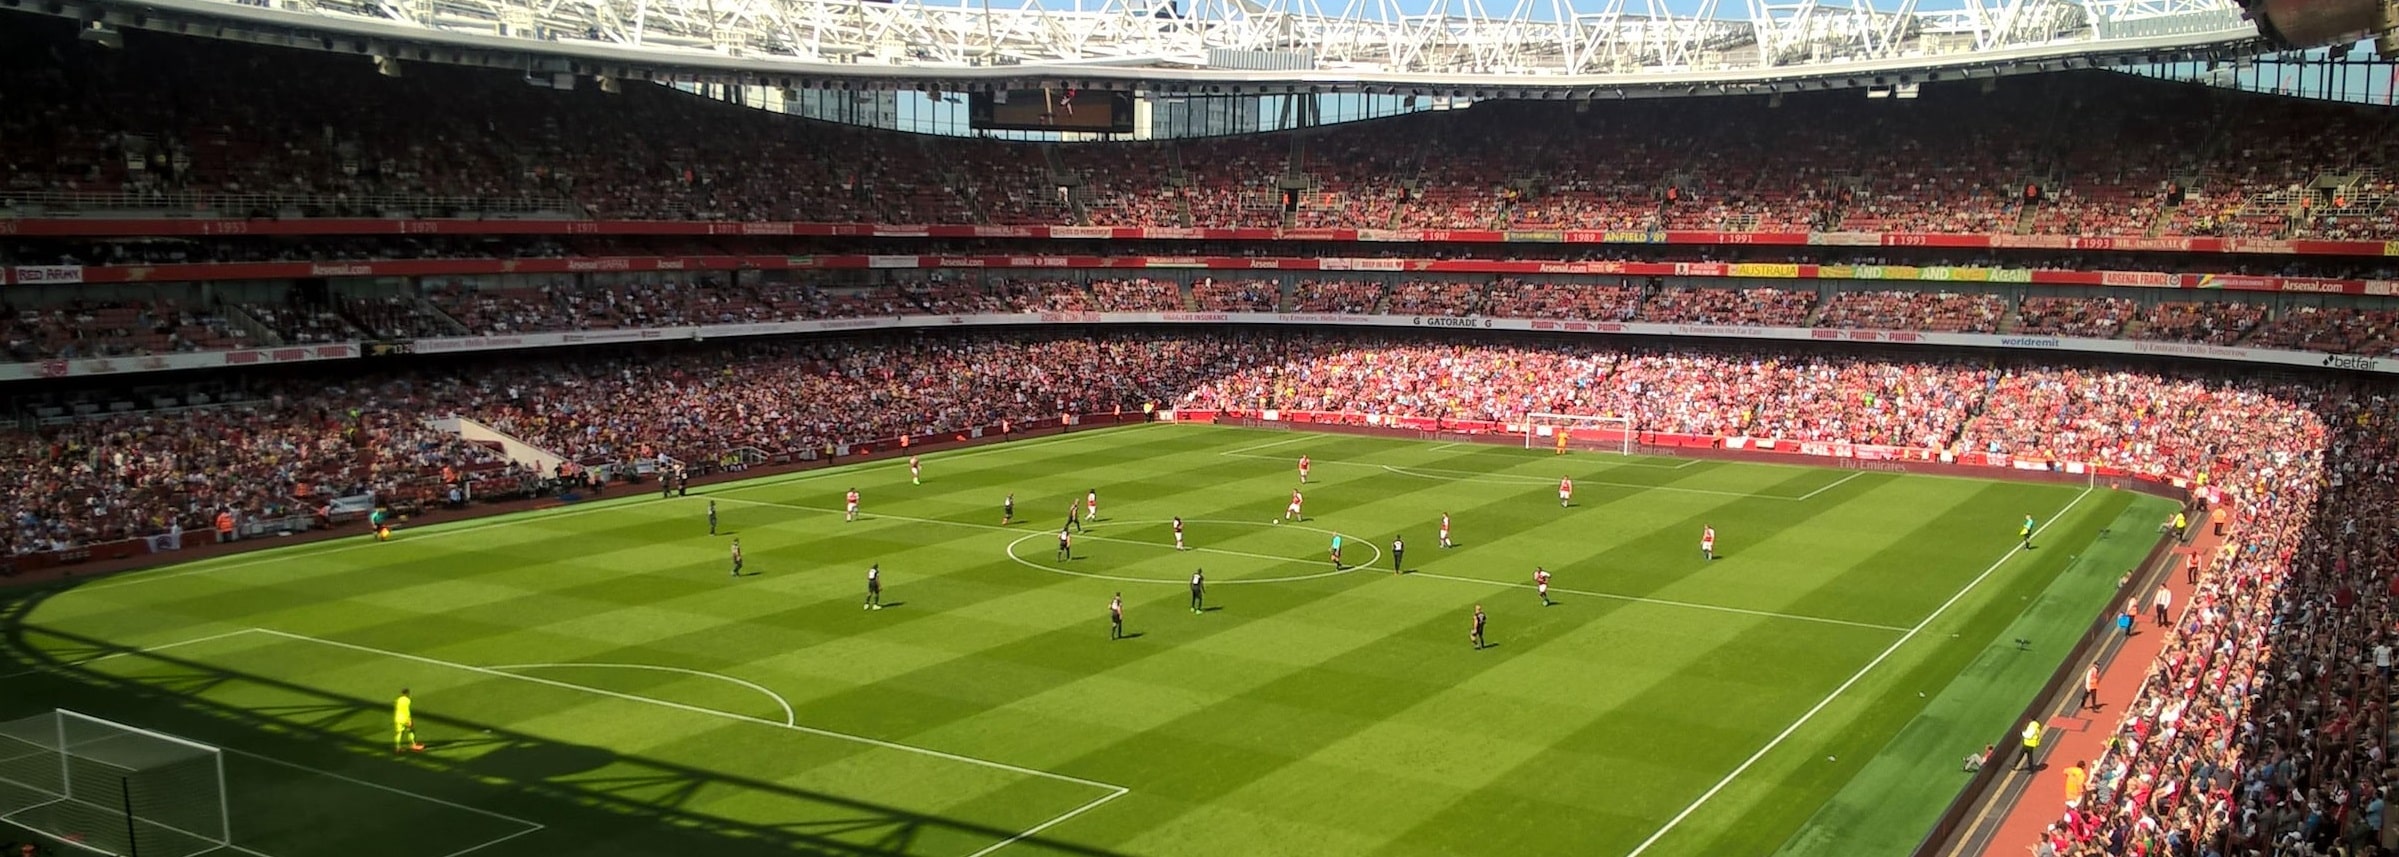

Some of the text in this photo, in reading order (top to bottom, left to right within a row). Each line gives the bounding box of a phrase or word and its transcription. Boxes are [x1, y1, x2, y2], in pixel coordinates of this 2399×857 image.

[1429, 232, 1451, 240] 1987
[1573, 233, 1596, 241] 1989
[1604, 233, 1647, 241] ANFIELD
[1729, 235, 1753, 243] 1991
[1900, 236, 1926, 245] 1993
[2084, 239, 2110, 247] 1993
[940, 257, 985, 267] Arsenal.com
[1250, 259, 1279, 269] Arsenal
[313, 265, 372, 276] Arsenal.com
[1540, 263, 1588, 273] Arsenal.com
[1739, 265, 1798, 276] AUSTRALIA
[19, 268, 79, 280] RED ARMY
[1855, 266, 1882, 279] AND
[1921, 267, 1949, 280] AND
[1989, 269, 2030, 282] AGAIN
[2107, 273, 2168, 286] ARSENAL FRANCE
[2282, 280, 2343, 293] Arsenal.com
[1427, 318, 1477, 327] GATORADE
[1531, 321, 1621, 331] PUMA PUMA PUMA
[1811, 330, 1917, 341] PUMA PUMA PUMA
[2001, 338, 2060, 347] worldremit
[226, 346, 348, 363] PUMA PUMA PUMA
[2335, 355, 2379, 371] betfair
[1863, 461, 1906, 471] Emirates
